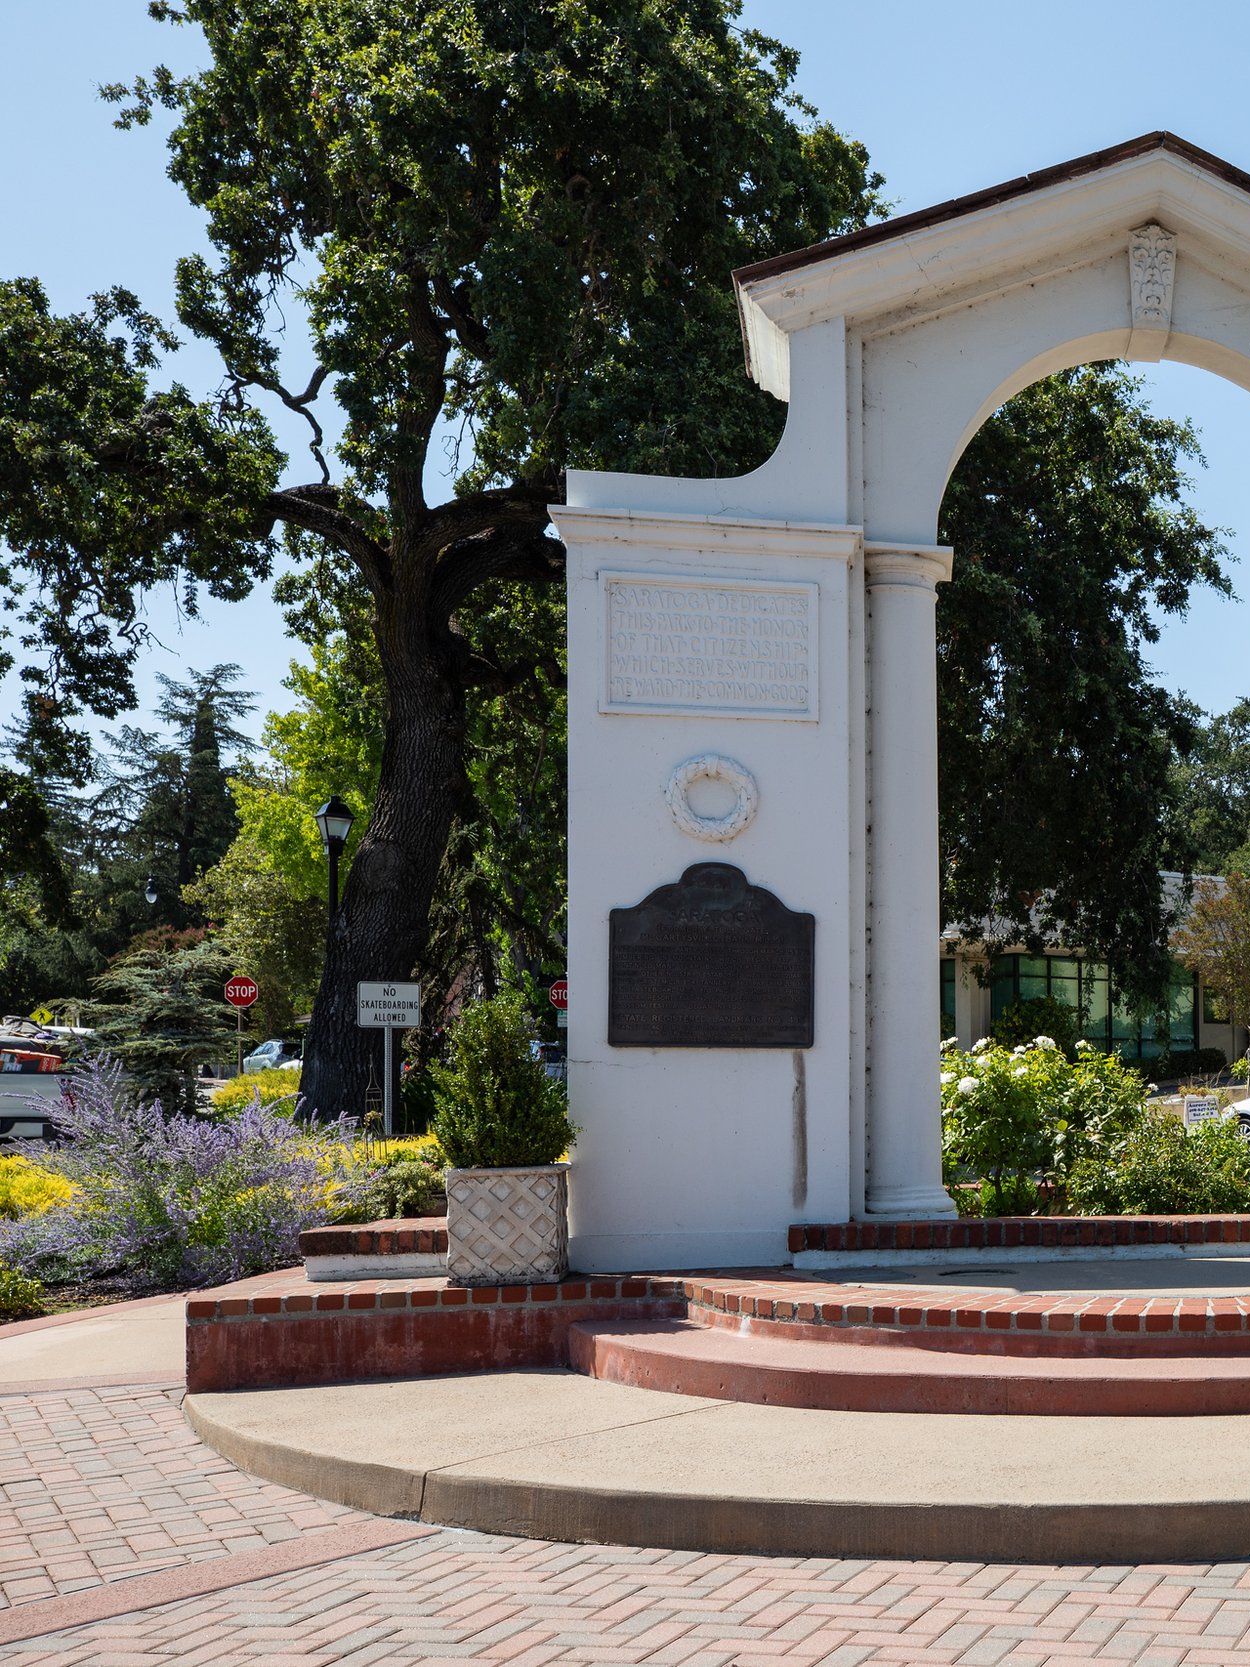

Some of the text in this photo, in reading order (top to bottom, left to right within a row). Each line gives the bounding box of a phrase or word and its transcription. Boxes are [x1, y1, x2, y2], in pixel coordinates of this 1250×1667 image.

[614, 587, 808, 615] SARATOGA DEDICATES
[614, 610, 808, 638] THIS PARK TO THE HONOR
[614, 632, 807, 661] OF THAT CITIZENSHIP
[613, 655, 809, 681] WHICH SERVES WITHOUT
[614, 676, 808, 703] REWARD THE COMMON GOOD
[667, 908, 760, 923] ARATOGA
[227, 985, 256, 998] STOP
[383, 988, 396, 997] NO
[551, 989, 568, 1000] STO
[360, 1000, 418, 1010] SKATEBOARDING
[373, 1013, 406, 1022] ALLOWED
